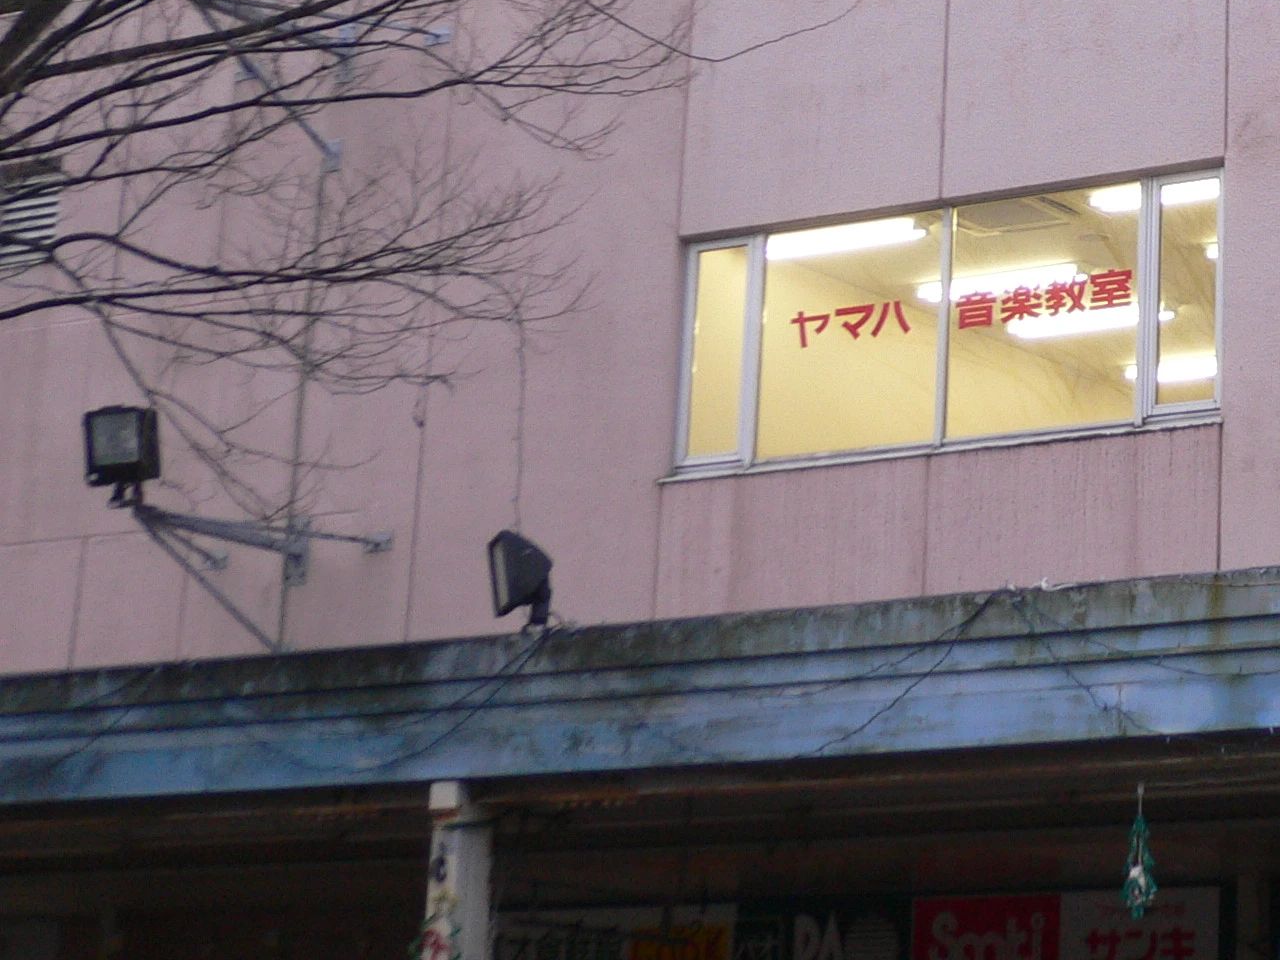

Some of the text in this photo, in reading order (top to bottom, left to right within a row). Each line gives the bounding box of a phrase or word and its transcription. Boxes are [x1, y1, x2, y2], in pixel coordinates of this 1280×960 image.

[790, 268, 1133, 348] ヤマハ 音楽教室
